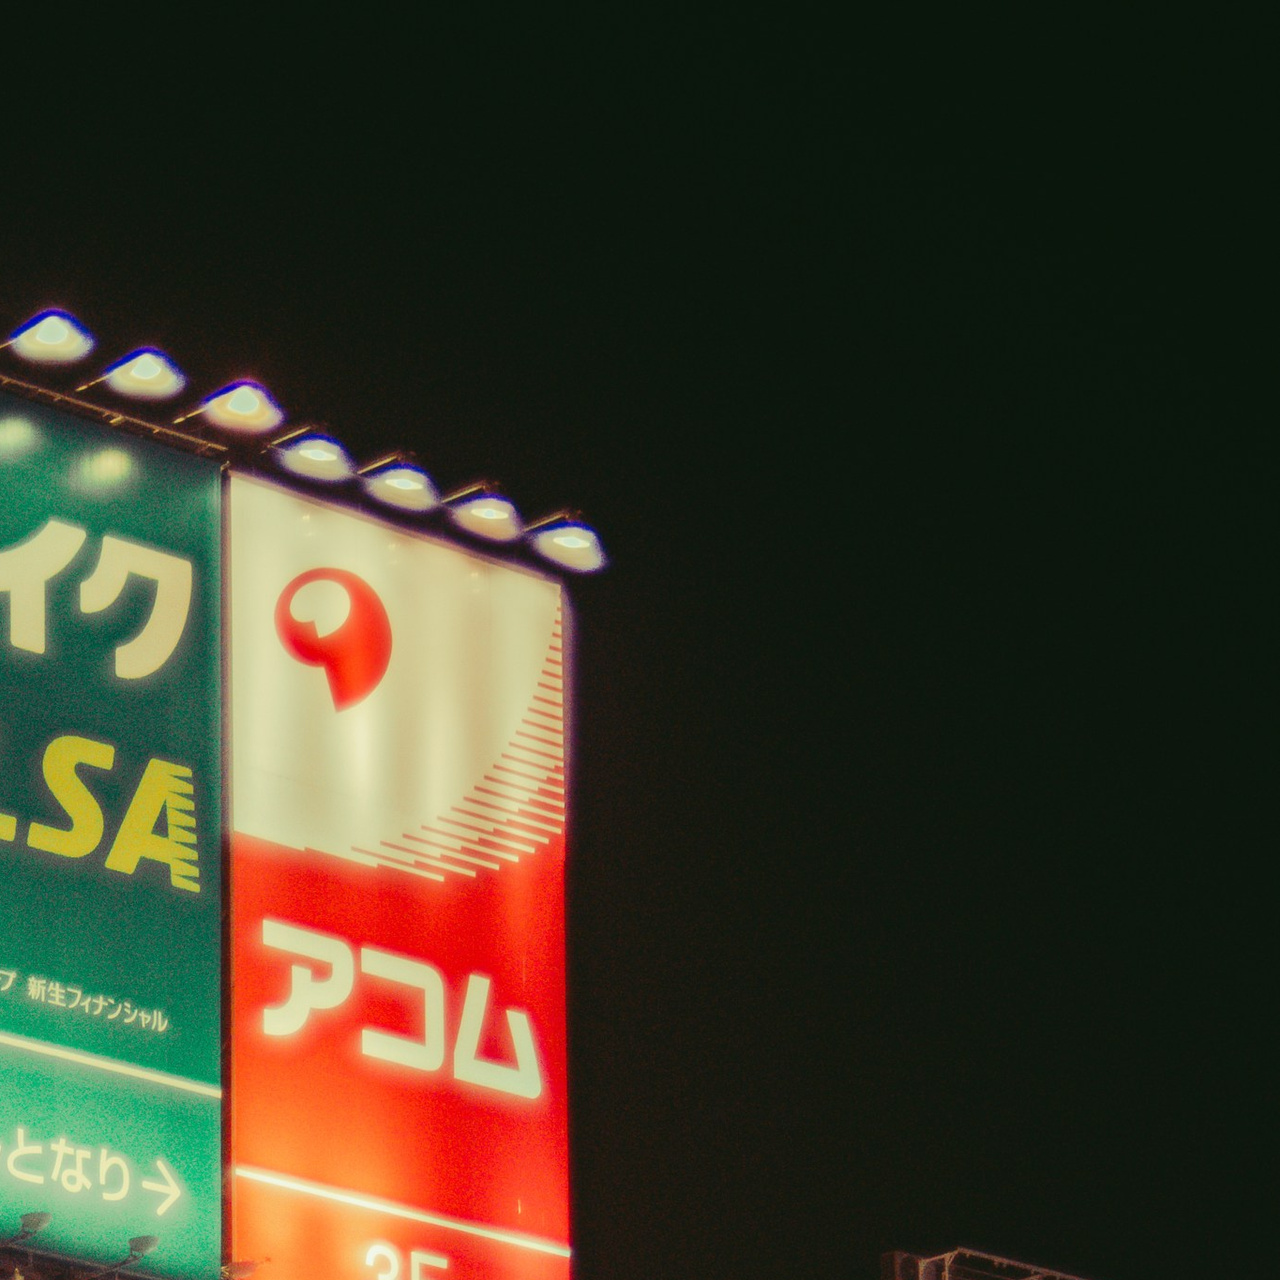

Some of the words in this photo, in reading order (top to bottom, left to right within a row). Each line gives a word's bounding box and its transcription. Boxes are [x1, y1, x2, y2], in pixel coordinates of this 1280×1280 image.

[27, 975, 168, 1032] 新生フィナンシャル
[262, 918, 542, 1099] アコム
